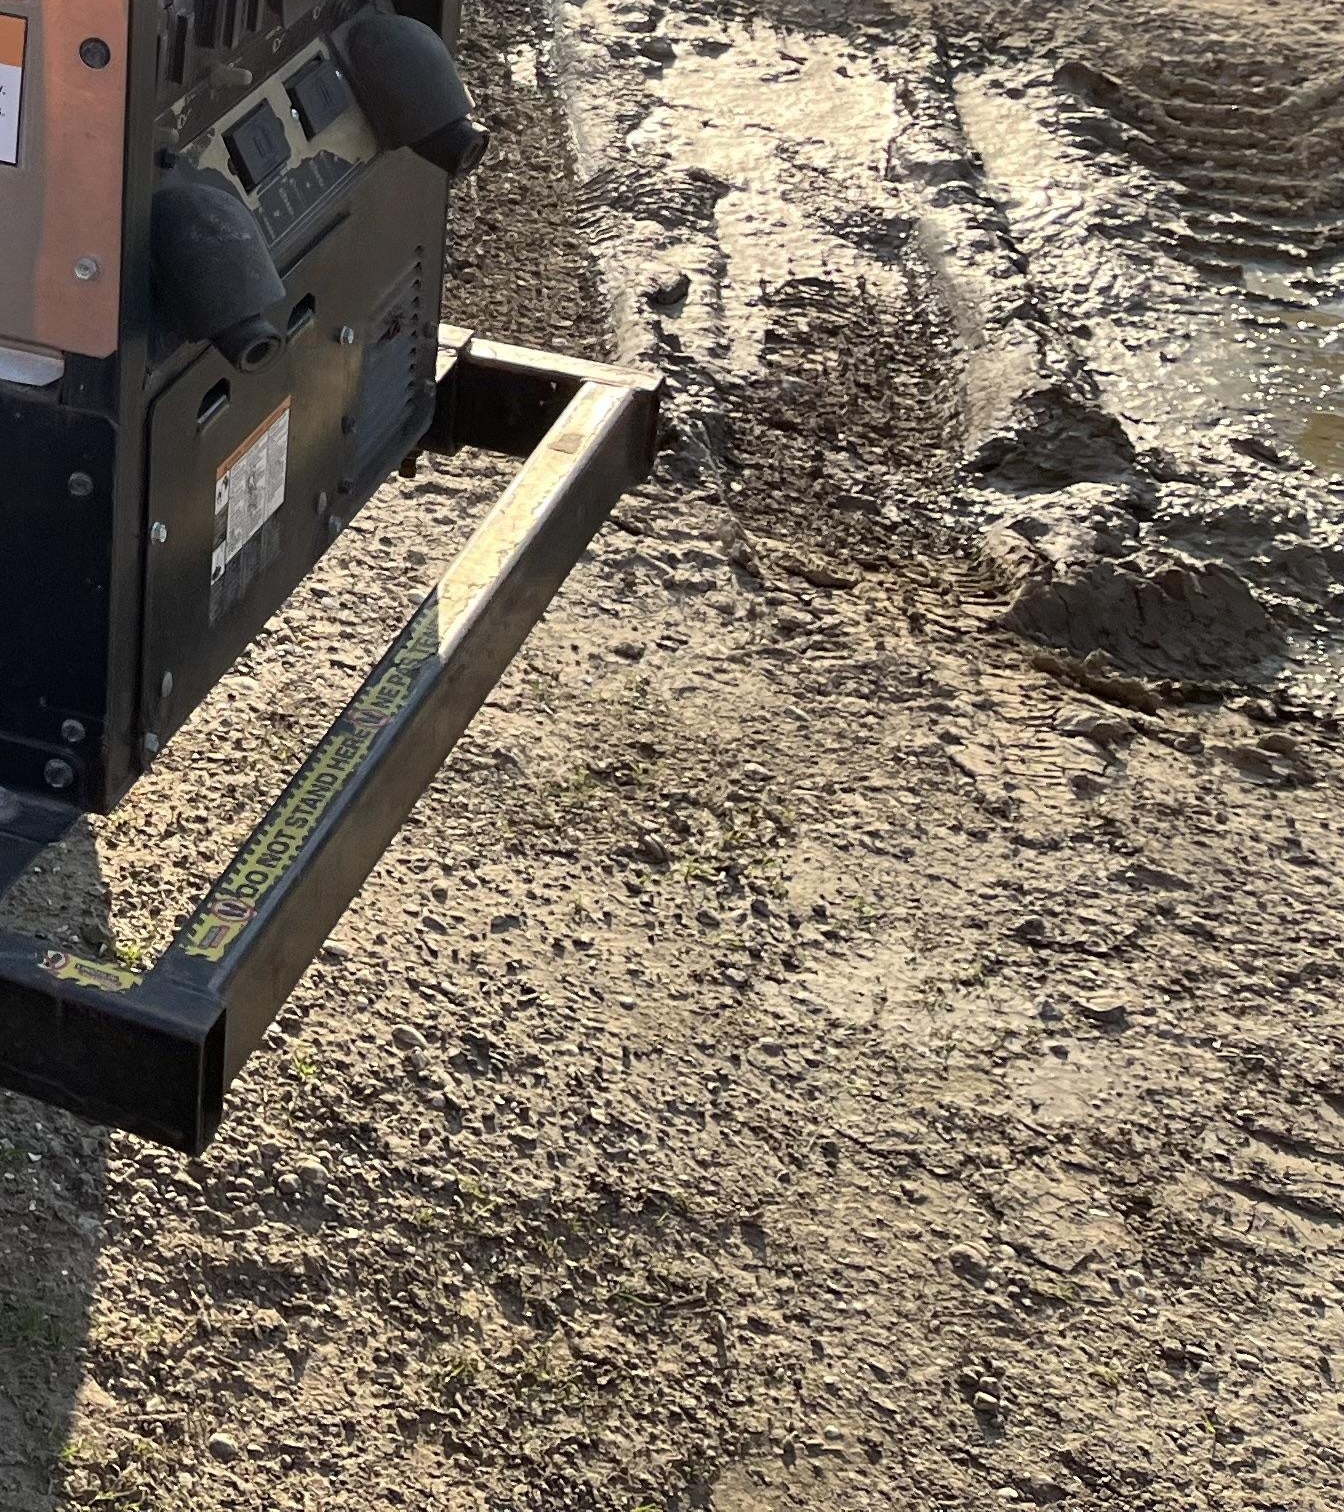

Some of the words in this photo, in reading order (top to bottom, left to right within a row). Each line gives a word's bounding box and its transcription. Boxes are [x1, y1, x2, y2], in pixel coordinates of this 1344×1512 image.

[232, 869, 269, 899] DO
[256, 828, 298, 869] NOT
[284, 771, 338, 830] STAND
[325, 728, 373, 772] HERE
